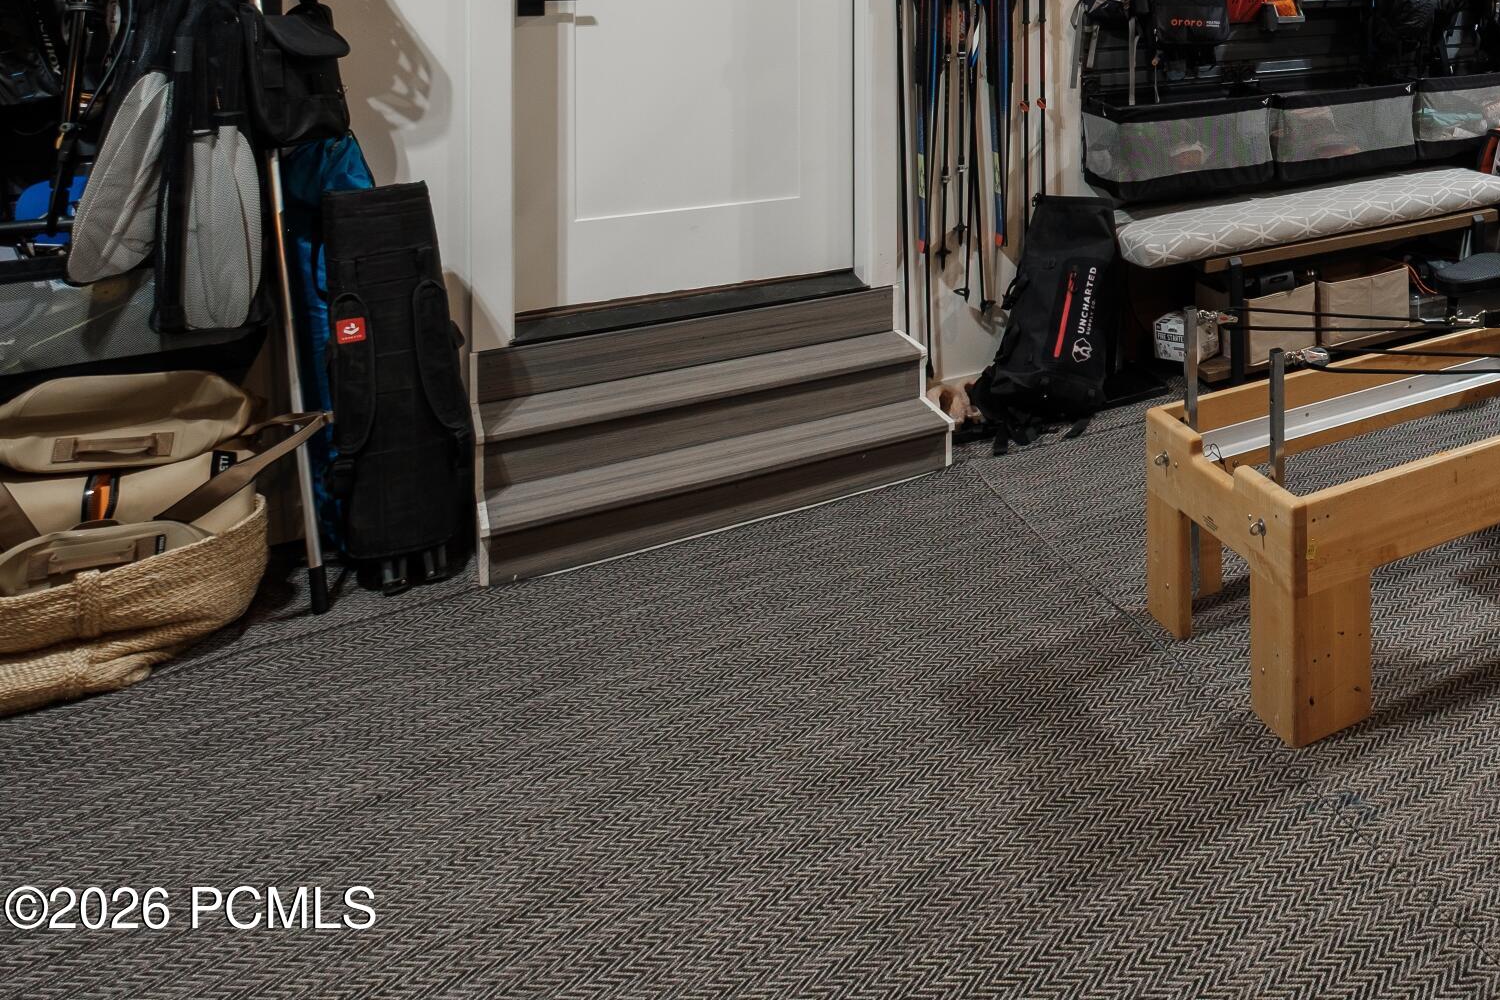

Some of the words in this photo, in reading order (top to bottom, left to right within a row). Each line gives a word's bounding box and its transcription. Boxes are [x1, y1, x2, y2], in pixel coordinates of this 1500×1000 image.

[1171, 18, 1203, 28] ororo
[1077, 266, 1097, 334] UNCHARTED
[1085, 311, 1095, 336] SUPPLY
